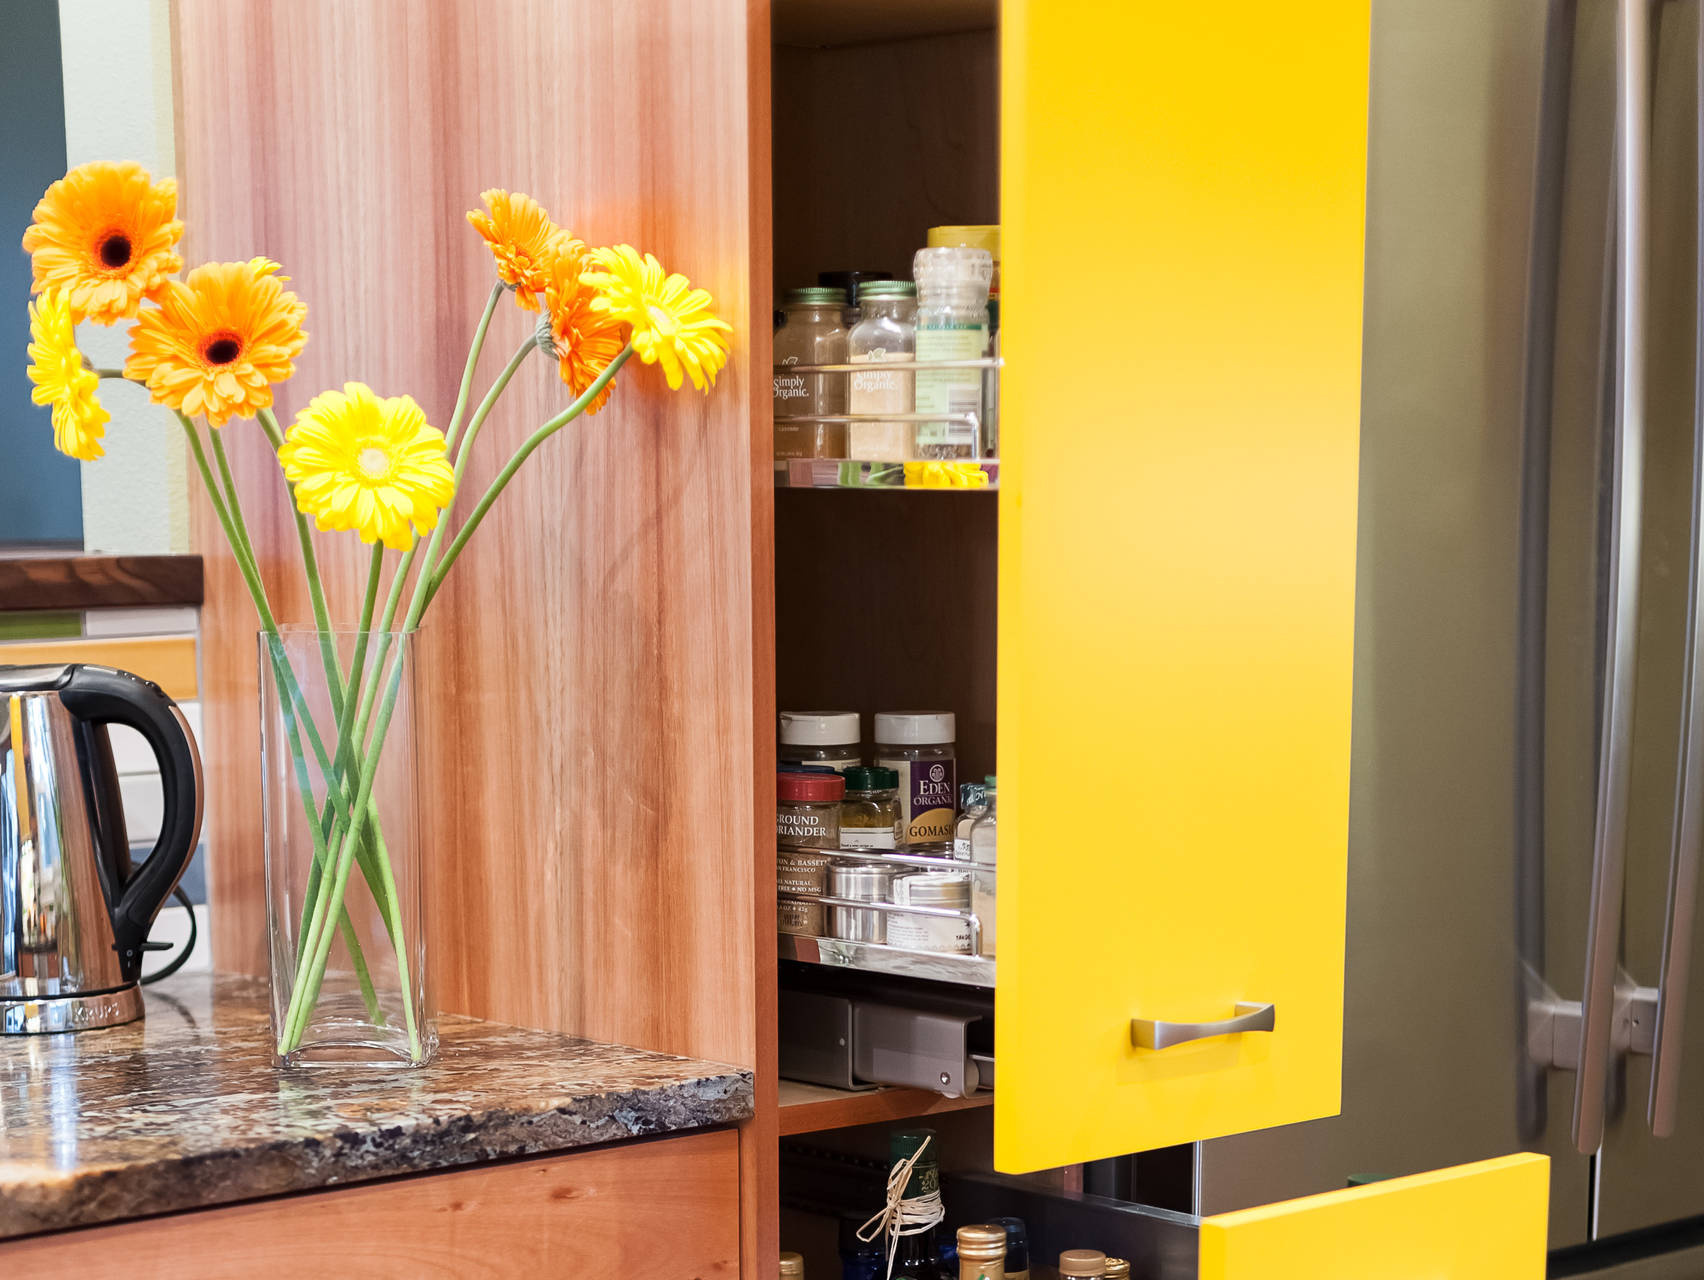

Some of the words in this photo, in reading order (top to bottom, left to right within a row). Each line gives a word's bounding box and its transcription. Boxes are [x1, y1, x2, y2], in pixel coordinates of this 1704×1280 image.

[774, 376, 805, 390] Simply
[919, 780, 950, 795] EDEN
[777, 814, 819, 825] ROUND
[776, 825, 826, 836] RIANDER
